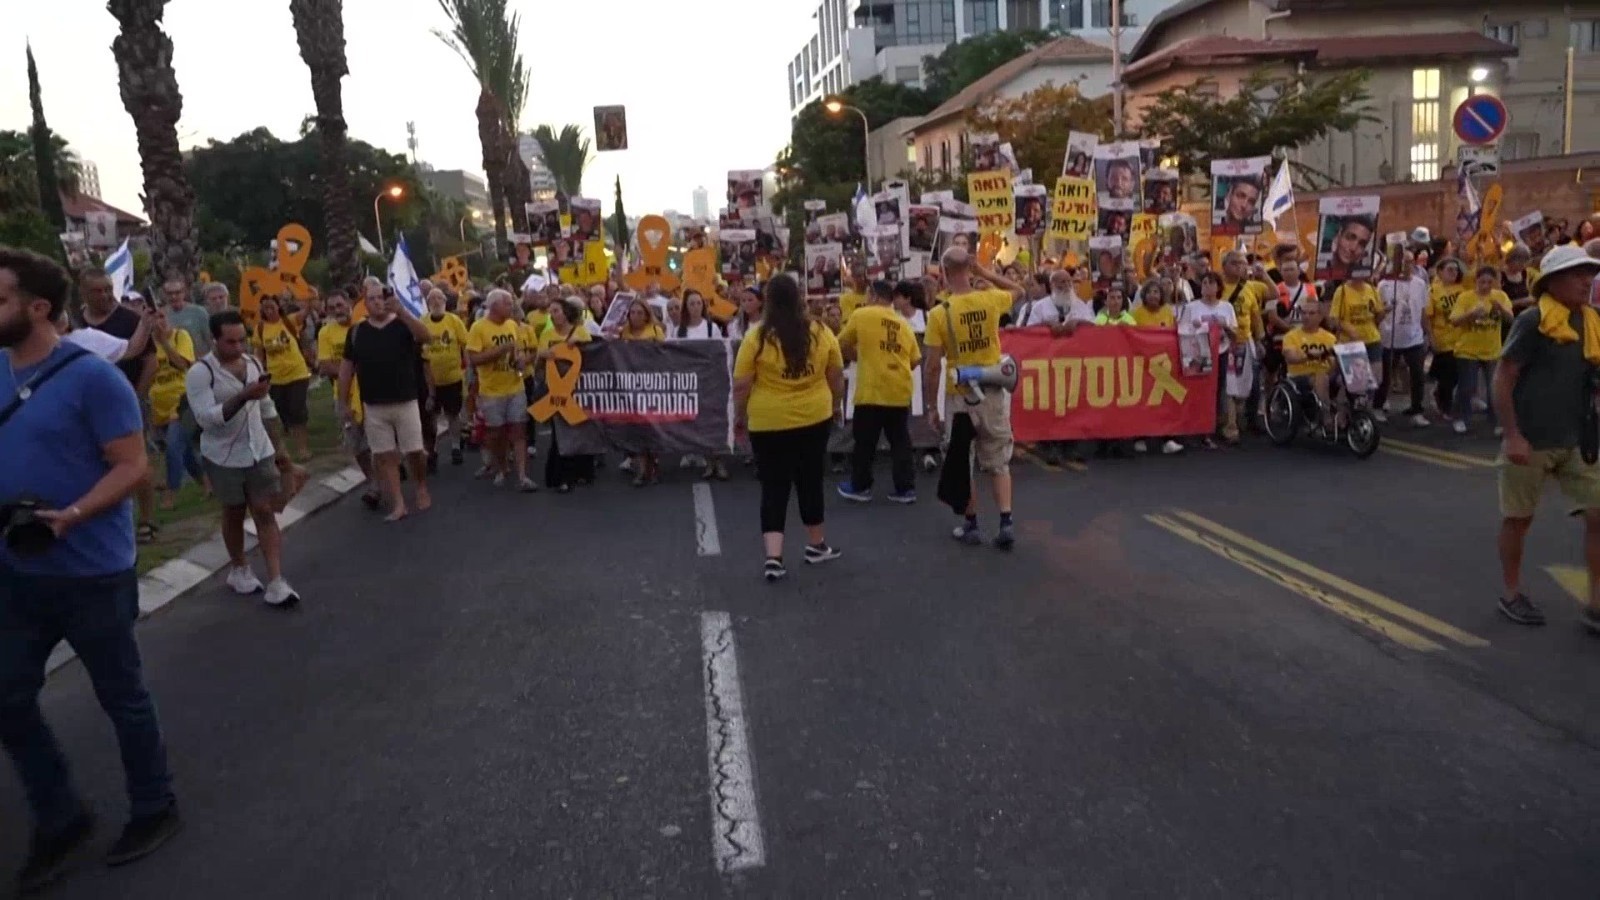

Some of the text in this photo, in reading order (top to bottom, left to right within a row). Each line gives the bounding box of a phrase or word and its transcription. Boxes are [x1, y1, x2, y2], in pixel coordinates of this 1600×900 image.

[973, 177, 1007, 191] רואה
[1058, 183, 1089, 197] רואה
[959, 310, 987, 325] עסקה
[577, 370, 698, 390] מטה המשפחות להחזר
[1021, 356, 1145, 417] עסקה
[637, 392, 699, 415] החטופים
